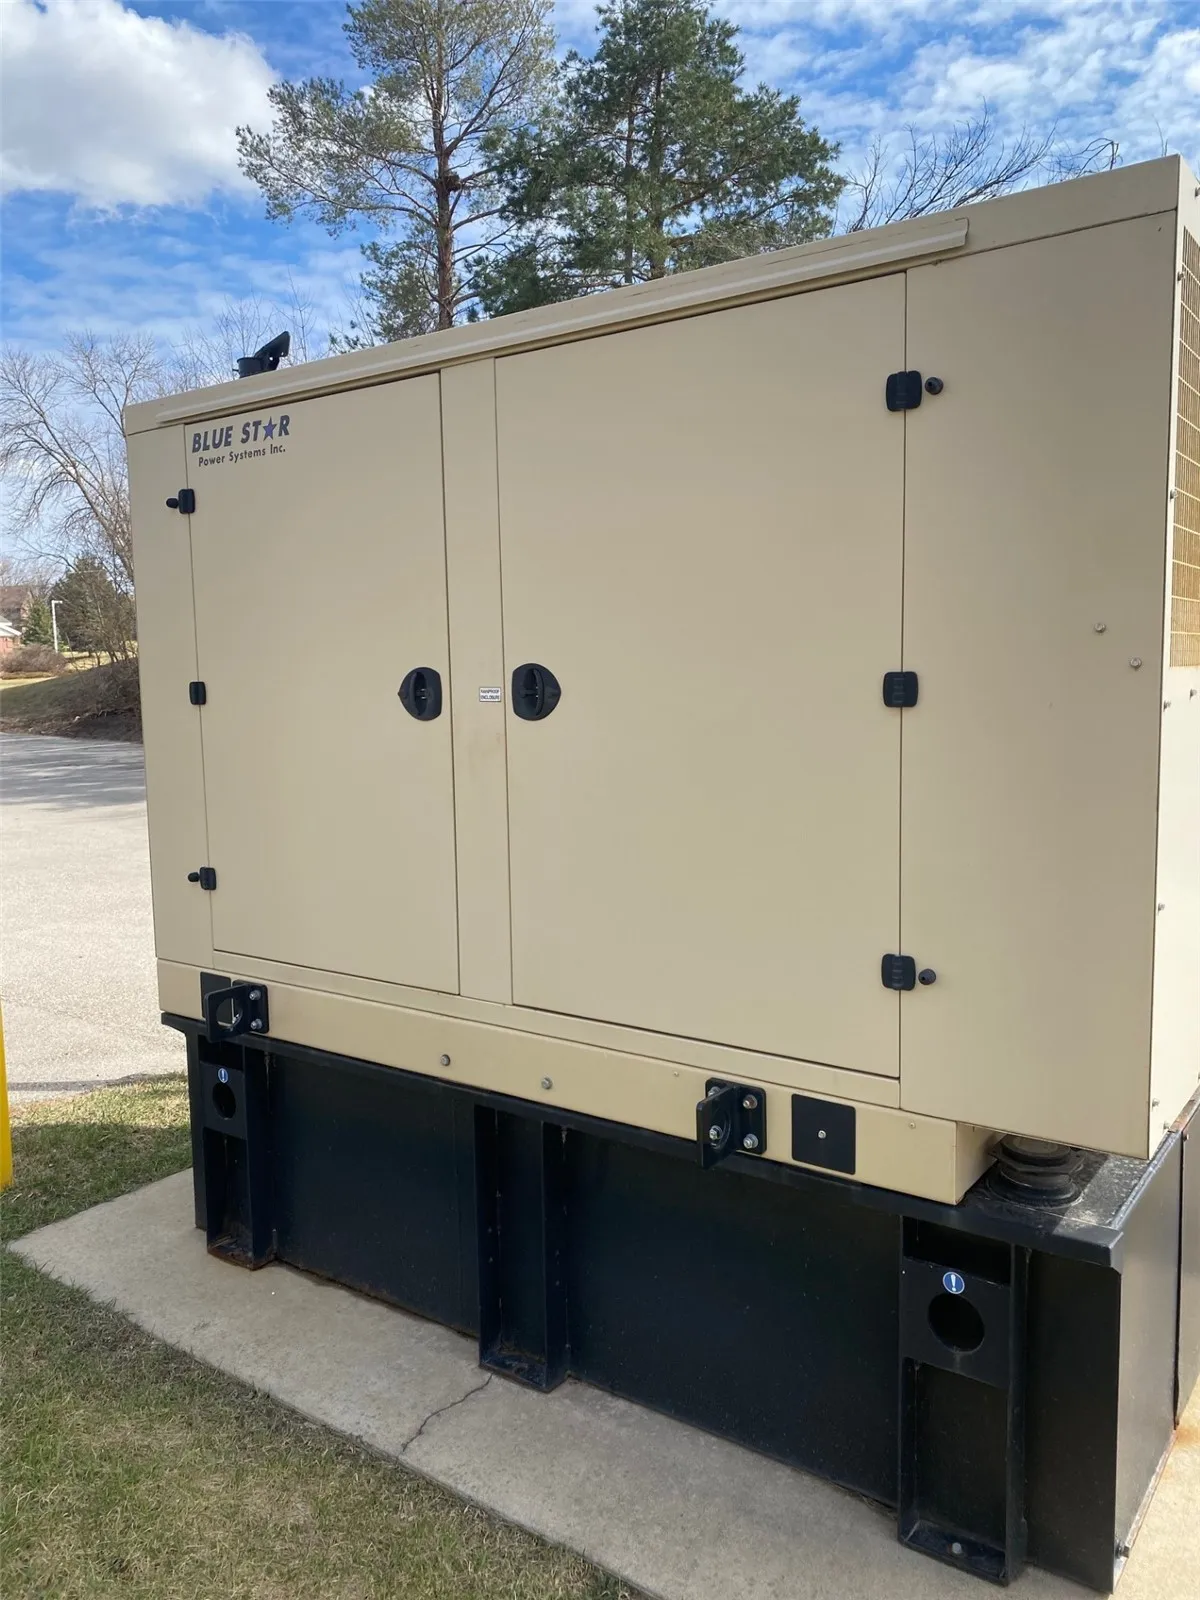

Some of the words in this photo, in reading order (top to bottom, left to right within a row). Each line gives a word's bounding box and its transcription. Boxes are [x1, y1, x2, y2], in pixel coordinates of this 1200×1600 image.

[192, 425, 234, 453] BLUE
[199, 456, 225, 467] Power
[229, 448, 265, 463] Systems
[270, 444, 286, 454] Inc.
